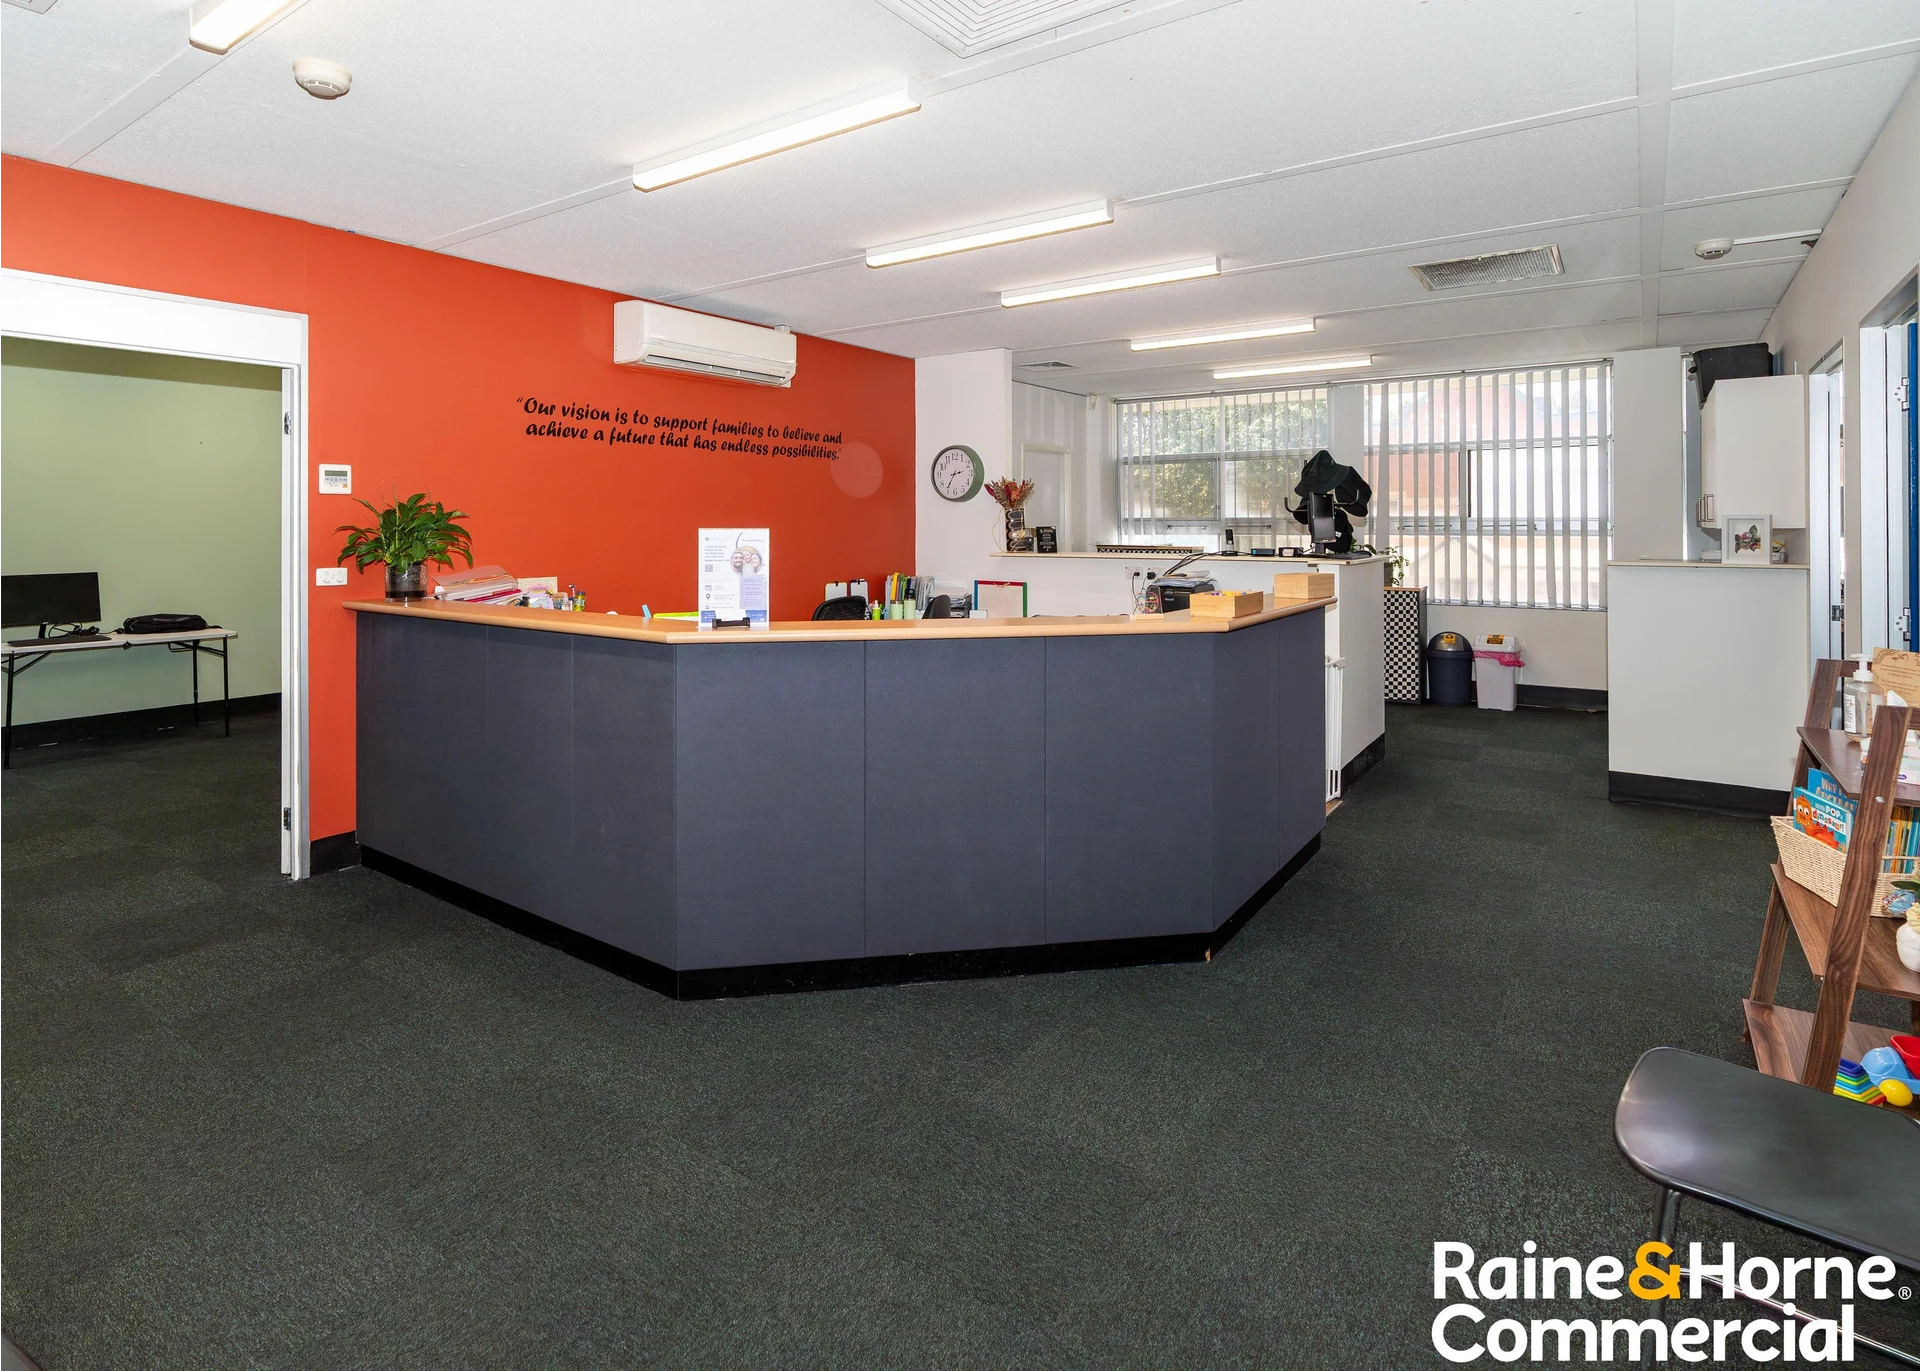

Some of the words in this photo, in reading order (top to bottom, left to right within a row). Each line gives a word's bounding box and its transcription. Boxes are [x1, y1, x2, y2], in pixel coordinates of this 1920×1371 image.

[525, 420, 588, 440] achieve
[593, 429, 605, 441] a
[609, 426, 656, 446] future
[659, 431, 690, 448] that
[693, 434, 717, 452] has
[720, 438, 769, 456] endless
[561, 401, 610, 422] vision
[614, 407, 628, 425] is
[632, 409, 649, 425] to
[653, 413, 708, 433] support
[711, 418, 764, 438] families
[767, 424, 780, 438] to
[782, 425, 820, 442] believe
[822, 431, 843, 444] and
[1825, 804, 1840, 818] POP
